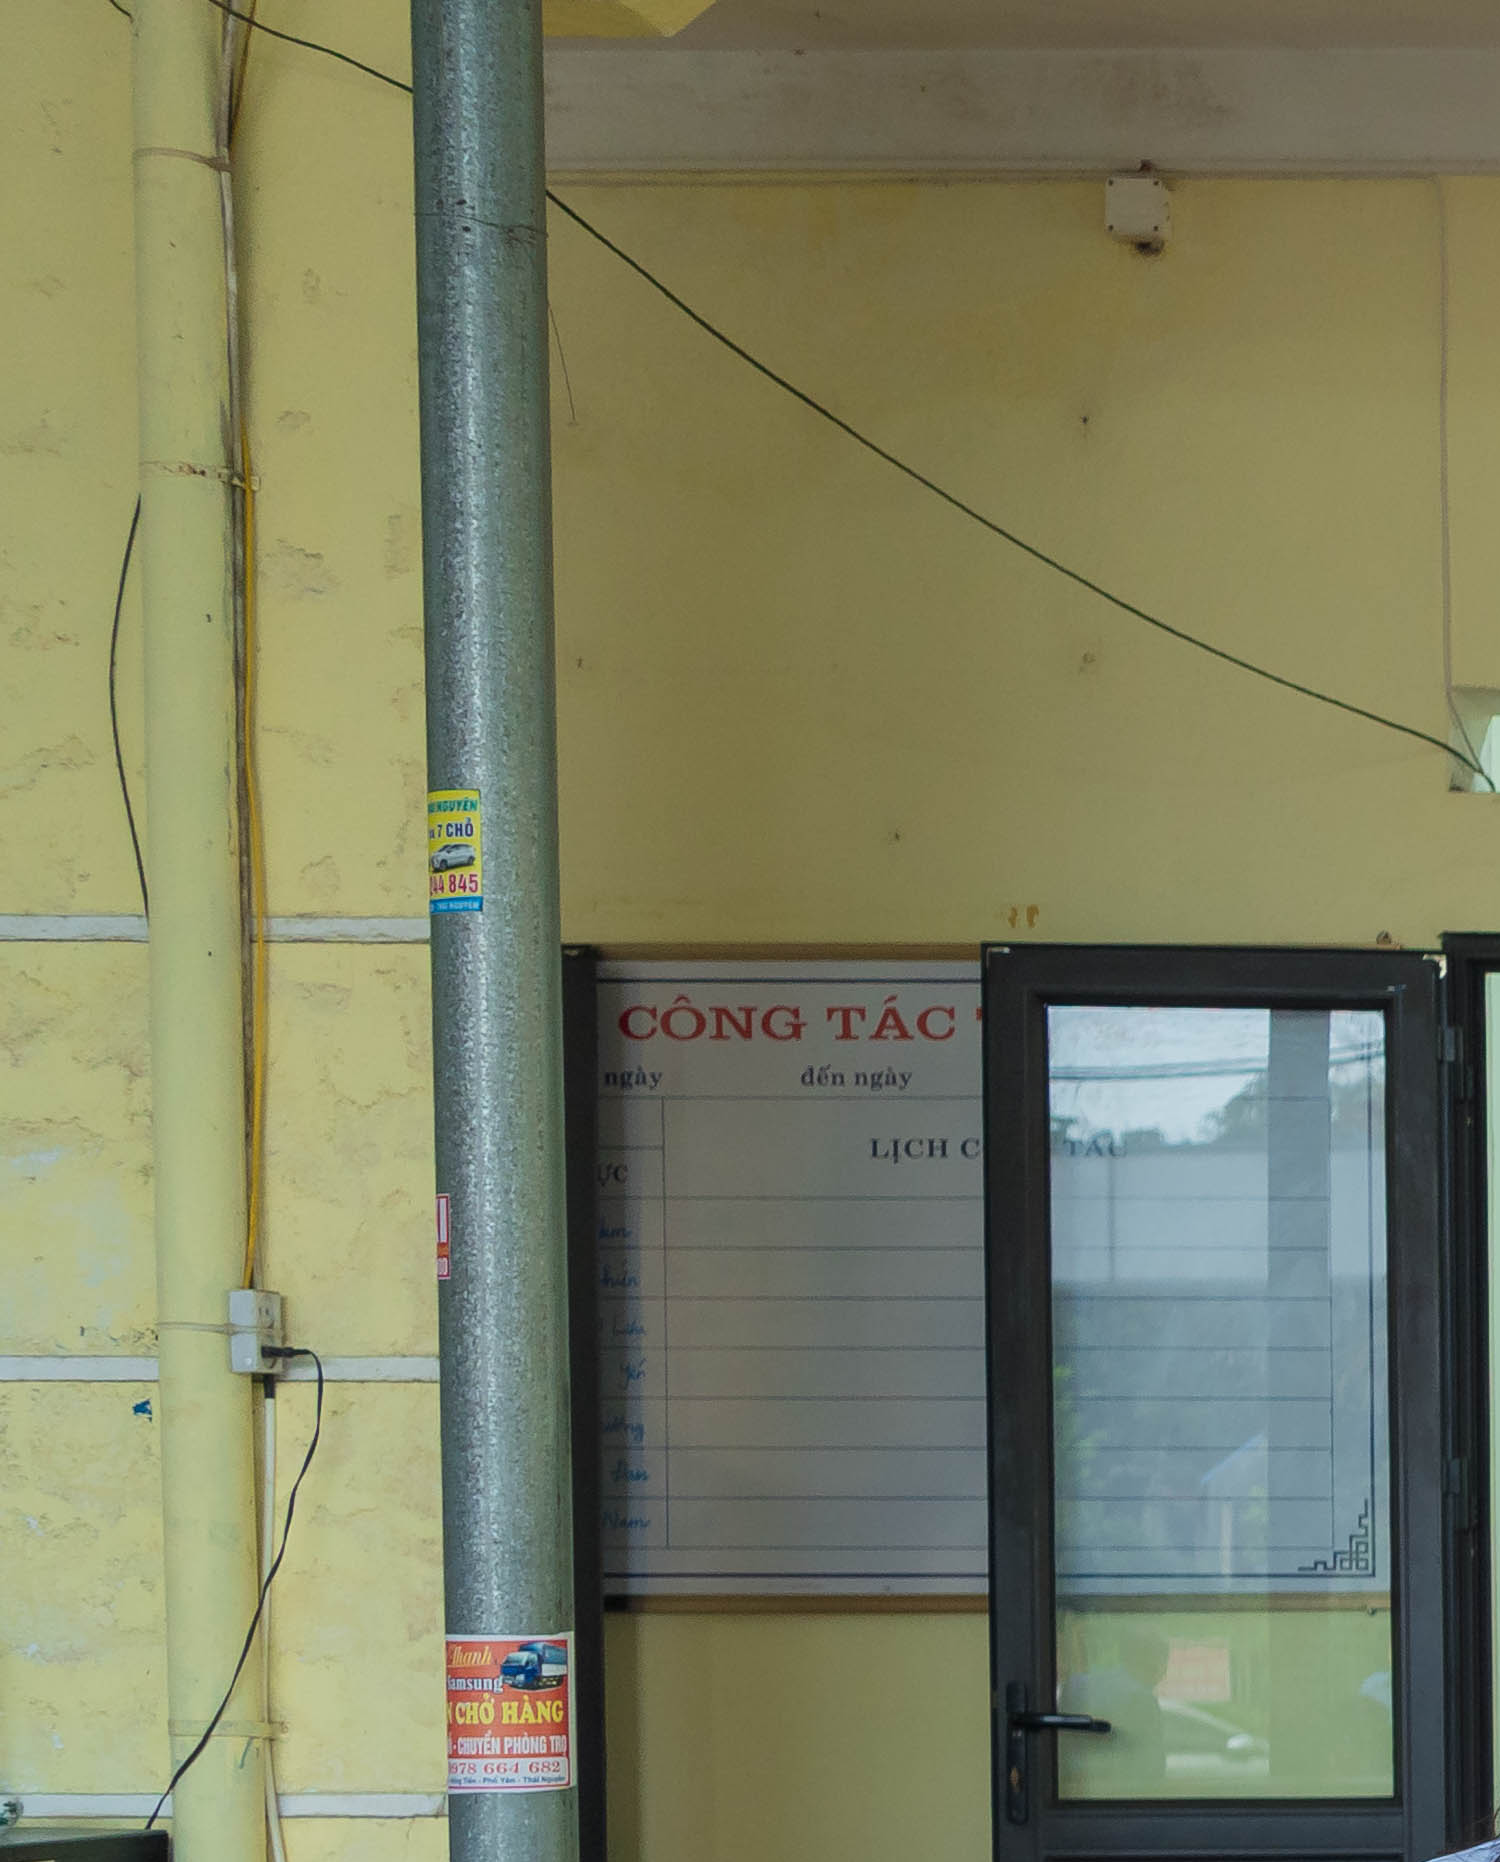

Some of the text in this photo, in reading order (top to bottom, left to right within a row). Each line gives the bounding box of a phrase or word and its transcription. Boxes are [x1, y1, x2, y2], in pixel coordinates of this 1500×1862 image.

[438, 825, 442, 836] 7
[448, 874, 478, 893] 845
[618, 994, 956, 1041] CÔNG TÁC
[605, 1065, 912, 1091] ngày đến ngày
[870, 1138, 948, 1164] LỊCH
[456, 1693, 495, 1724] CHỞ
[502, 1695, 564, 1724] HÀNG
[458, 1729, 500, 1754] CHUYỂN
[504, 1732, 546, 1754] PHÒNG
[484, 1761, 561, 1774] 664 682
